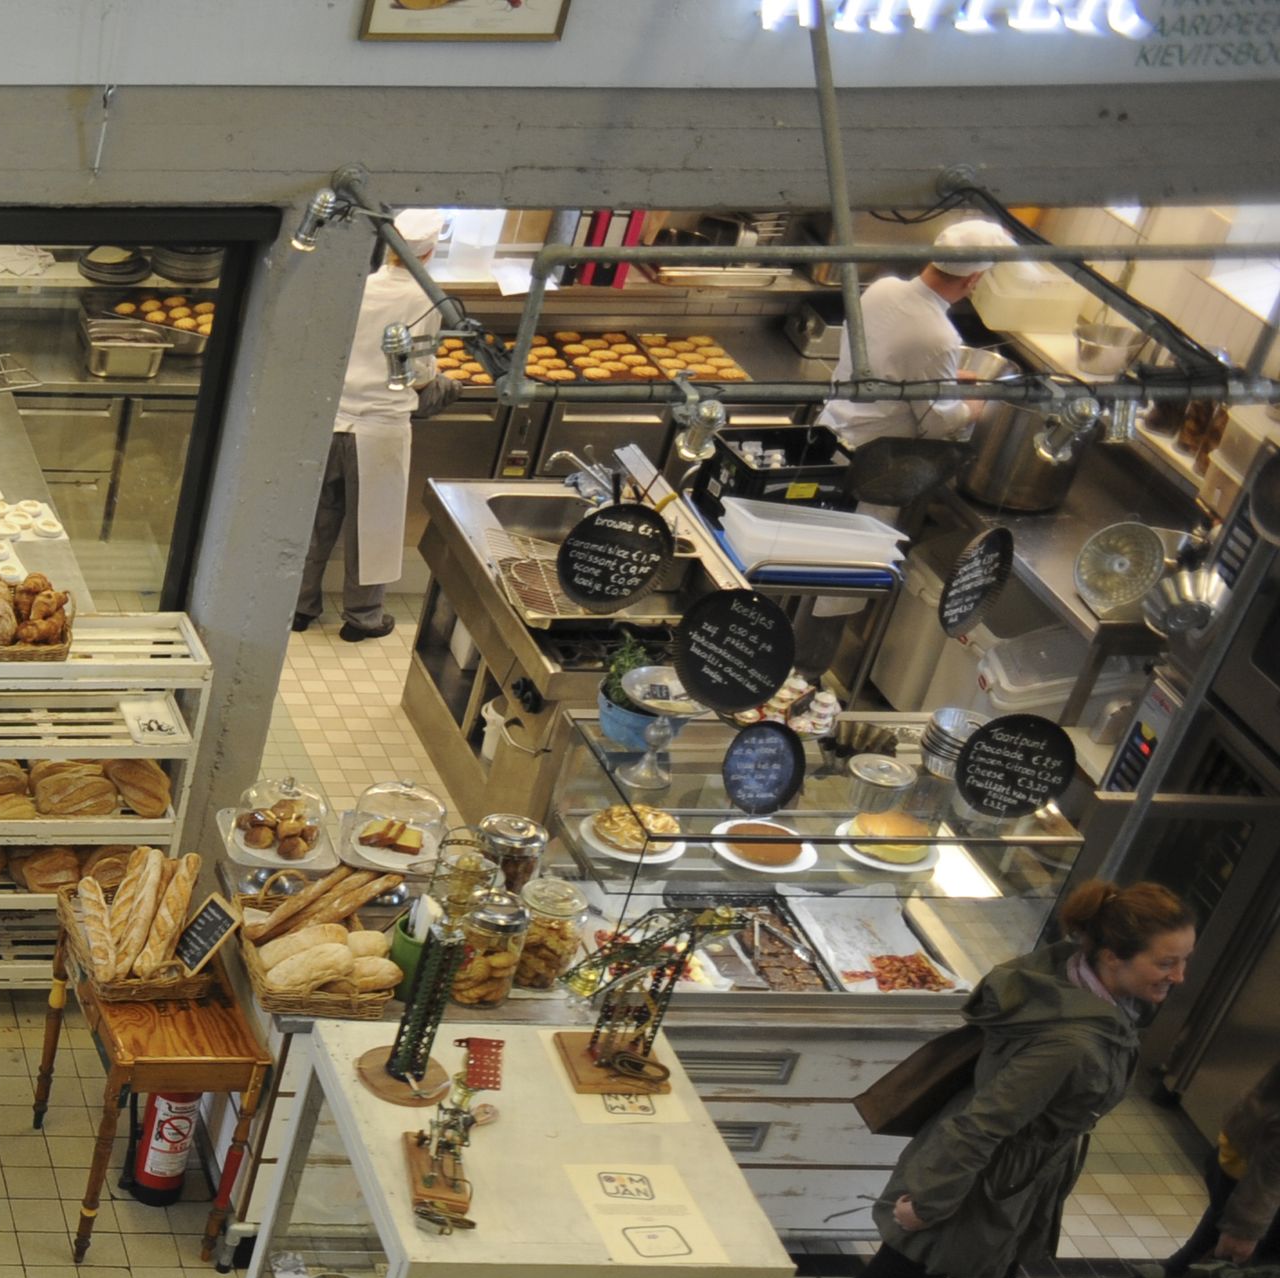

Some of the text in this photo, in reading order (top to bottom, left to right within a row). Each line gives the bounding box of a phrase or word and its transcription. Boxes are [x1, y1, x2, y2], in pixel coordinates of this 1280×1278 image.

[595, 516, 635, 533] brownie
[568, 549, 618, 572] croissant
[572, 562, 602, 578] scone
[973, 741, 1025, 763] Chocolade
[966, 764, 1007, 783] Cheese
